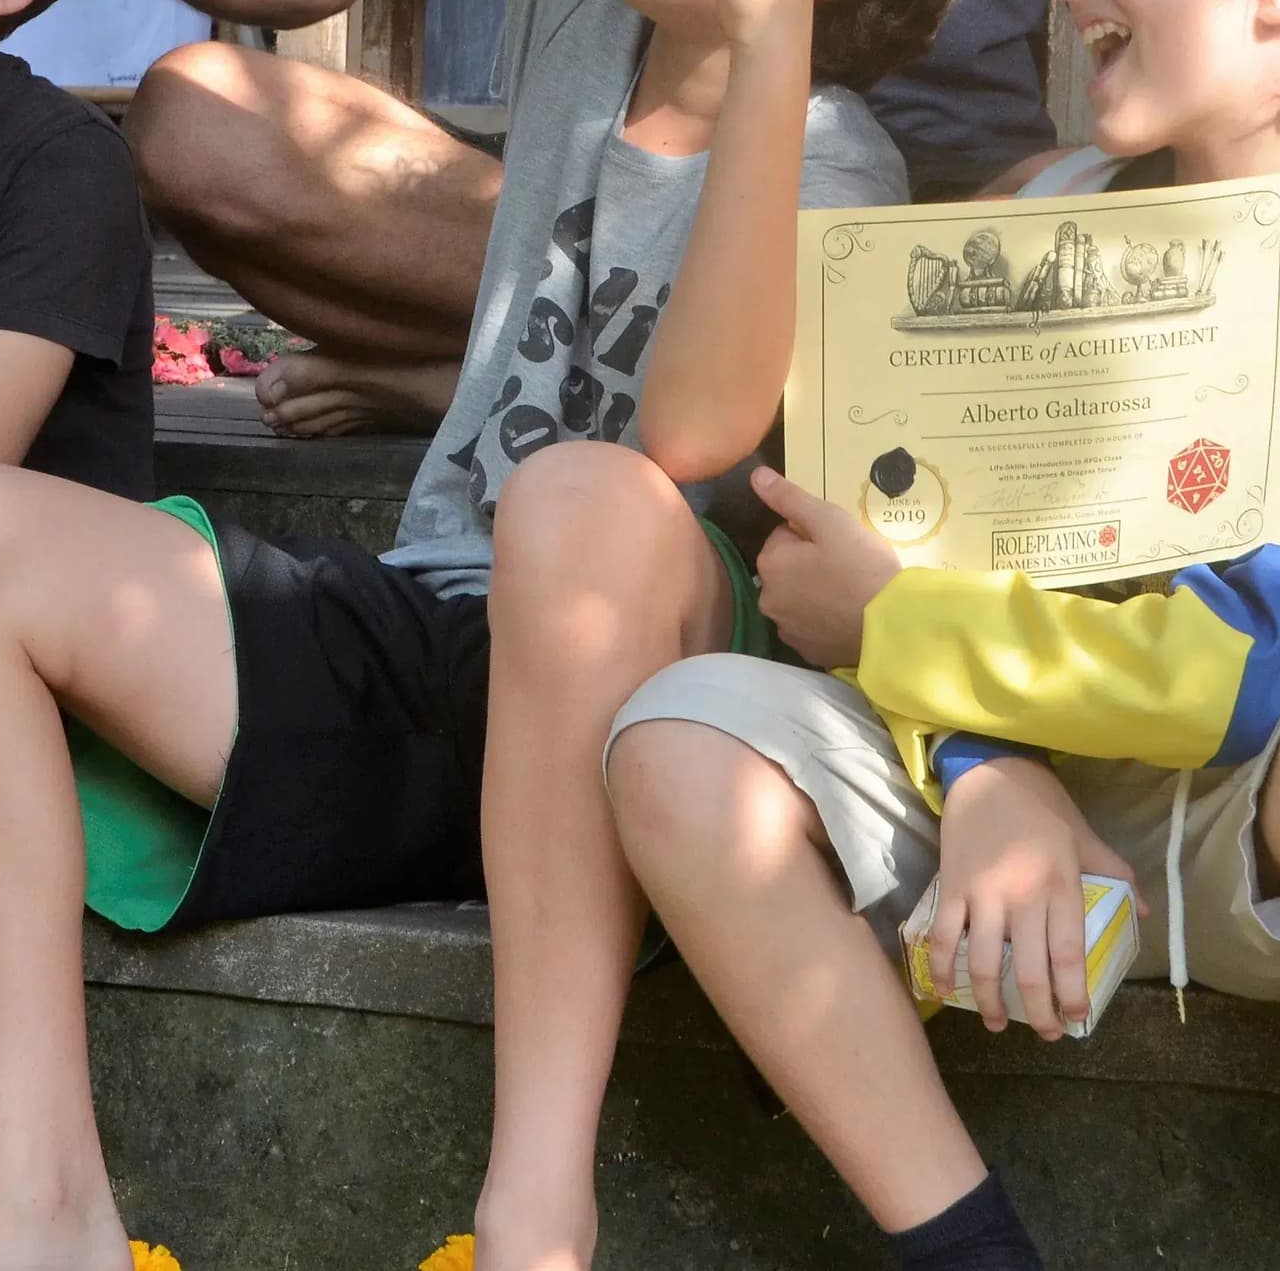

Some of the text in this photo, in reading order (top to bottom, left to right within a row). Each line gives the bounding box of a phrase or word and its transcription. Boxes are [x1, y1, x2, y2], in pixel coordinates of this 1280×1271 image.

[889, 326, 1219, 368] CERTIFICATE of ACHIEVEMENT
[960, 396, 1152, 424] Alberto Galtarossa
[883, 509, 926, 524] 2019
[995, 551, 1117, 570] GAMES IN SCHOOLS
